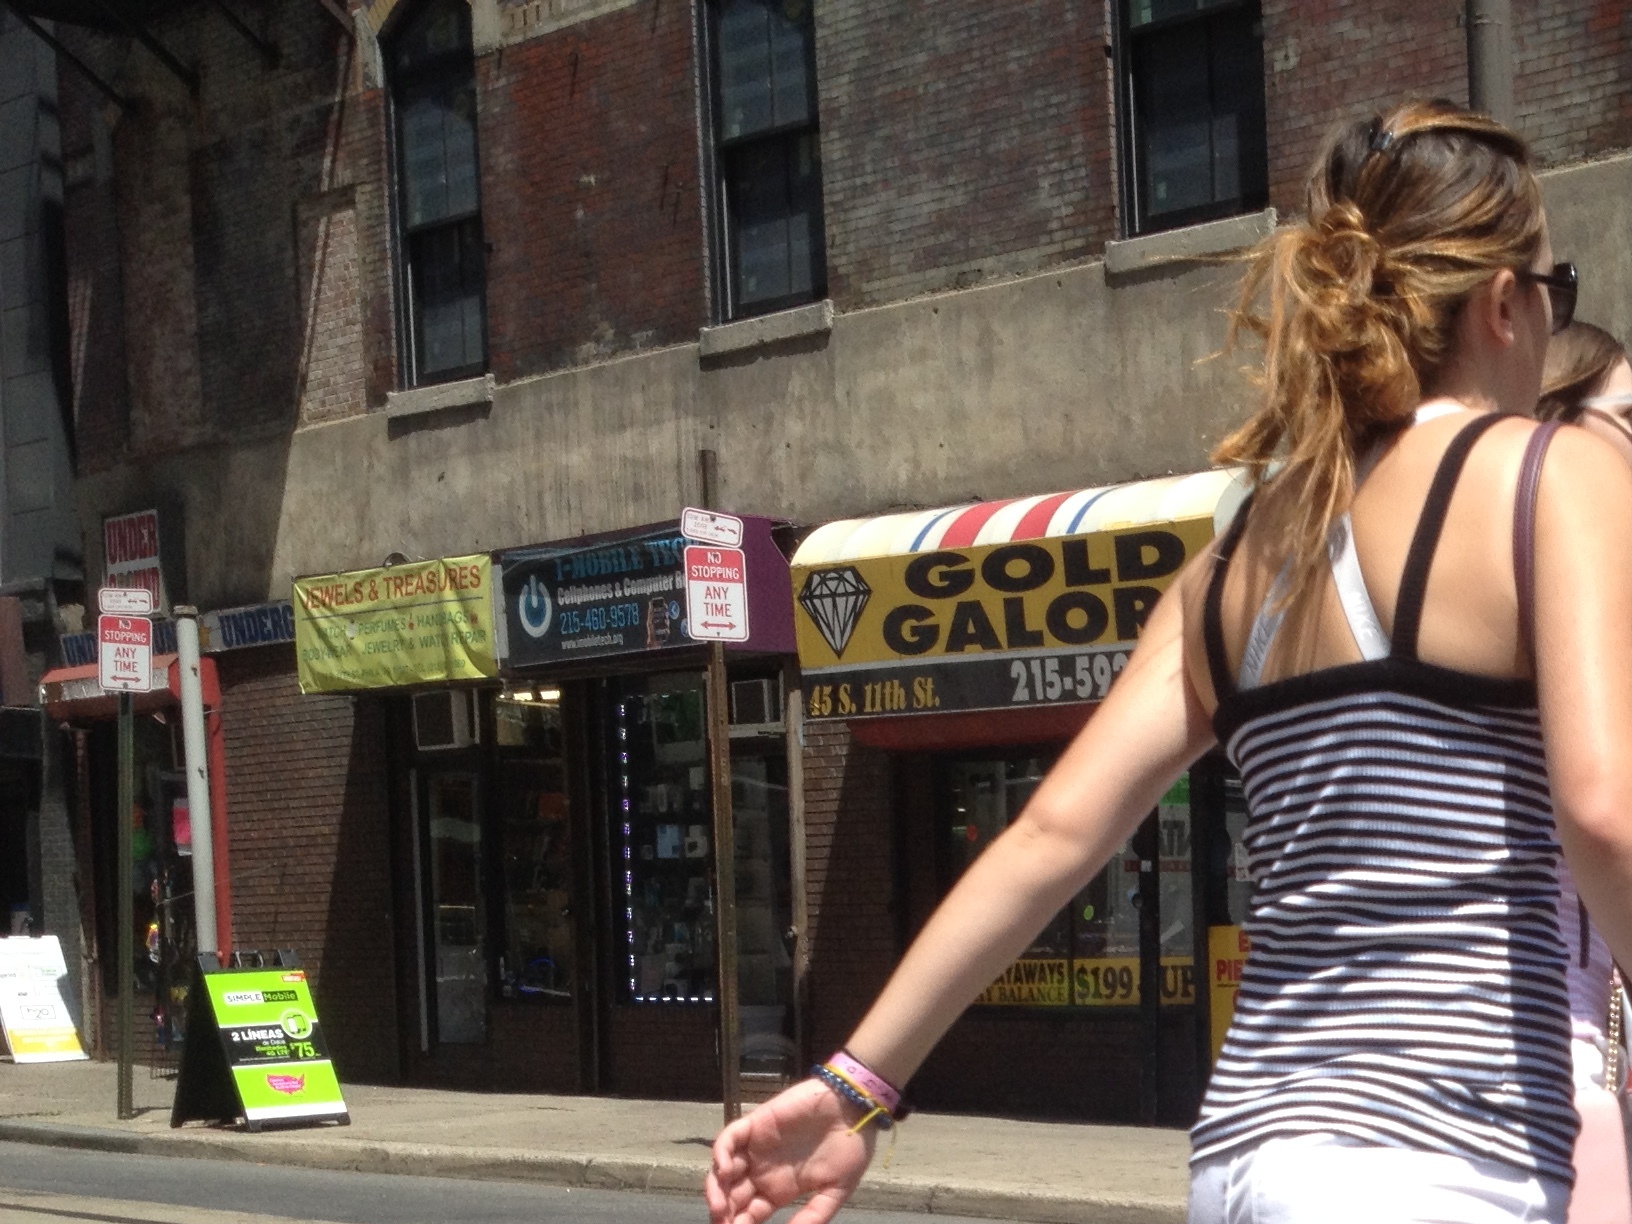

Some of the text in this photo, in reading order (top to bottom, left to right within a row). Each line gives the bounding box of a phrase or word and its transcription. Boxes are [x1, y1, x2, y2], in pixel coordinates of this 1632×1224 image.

[645, 536, 700, 567] TEC
[707, 551, 722, 564] NO
[691, 565, 740, 579] STOPPING
[904, 530, 1187, 600] GOLD
[303, 565, 481, 610] JEWELS & TREASURES
[623, 575, 673, 597] Computer
[705, 585, 729, 600] ANY
[703, 602, 732, 617] TIME
[118, 619, 131, 630] NO
[882, 585, 1164, 657] GALOR
[104, 629, 147, 643] STOPPING
[114, 646, 137, 660] ANY
[114, 660, 138, 673] TIME
[1009, 652, 1128, 703] 215-59
[810, 676, 941, 717] 45 S. 11th St.
[1076, 963, 1133, 1001] $199
[226, 990, 297, 1003] SIMPLE Mobile
[231, 1032, 241, 1042] 2
